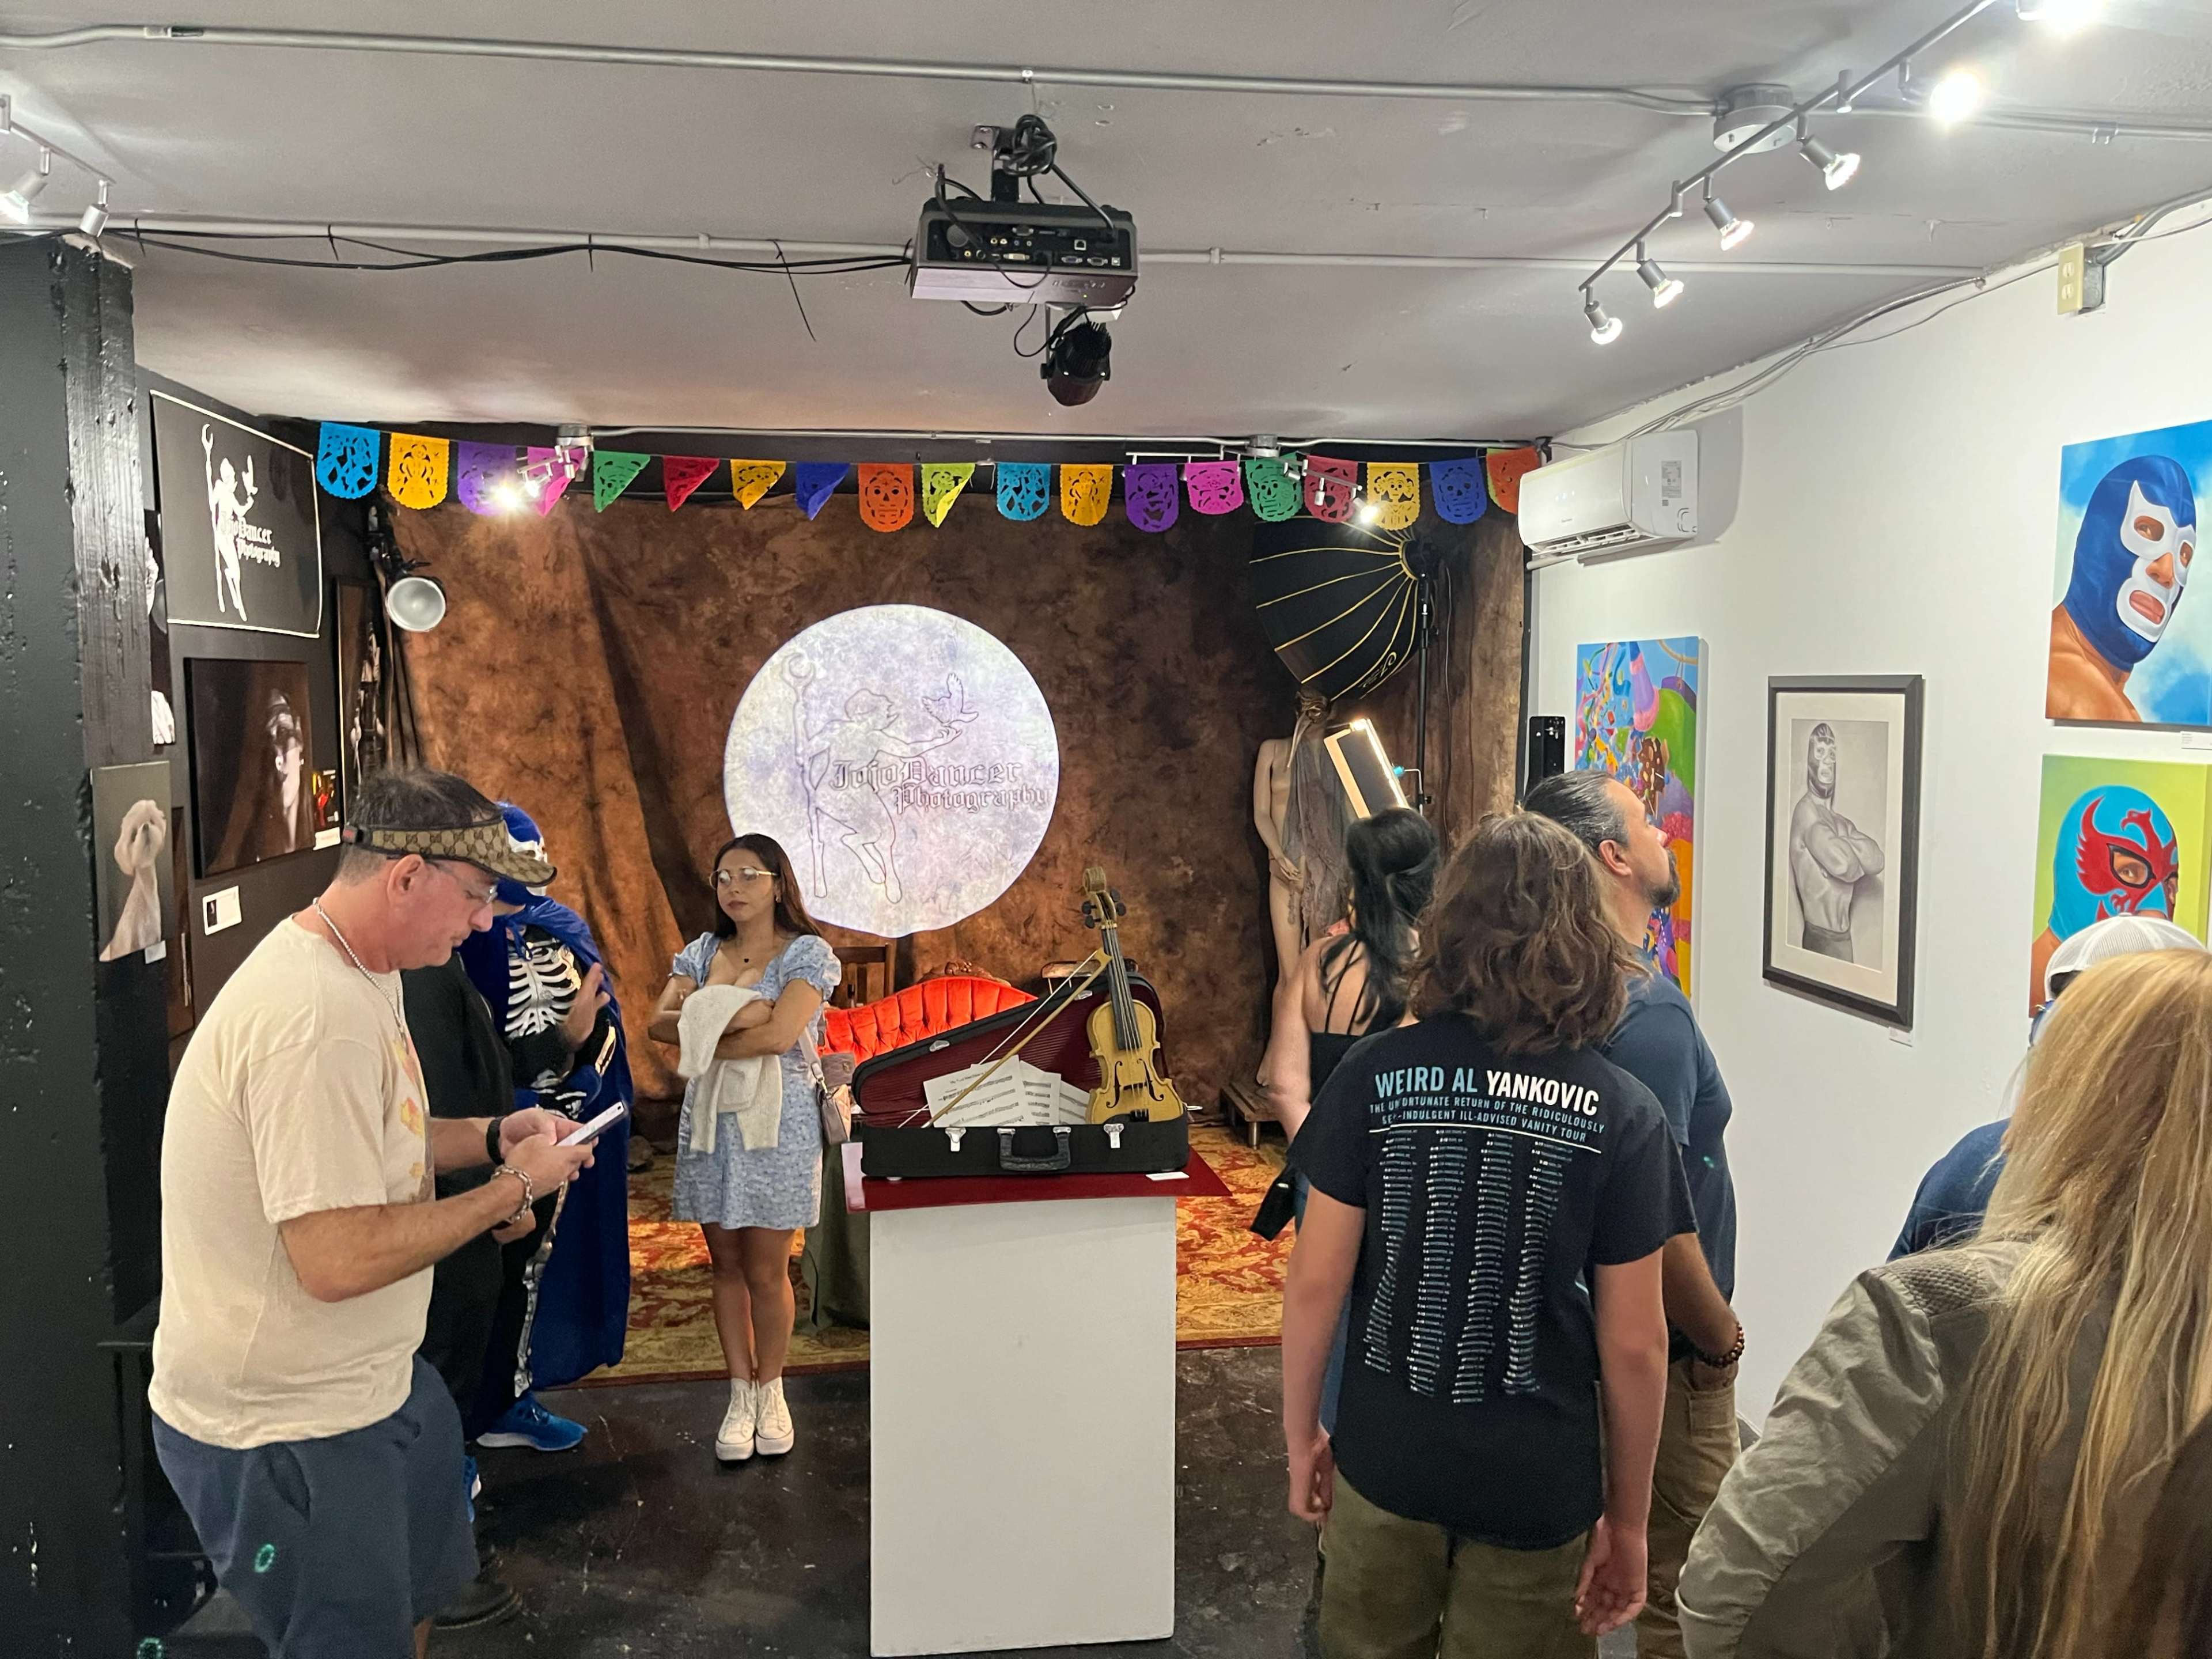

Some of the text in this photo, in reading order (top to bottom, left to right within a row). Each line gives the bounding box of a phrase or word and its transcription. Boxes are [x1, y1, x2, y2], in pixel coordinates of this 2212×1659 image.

[238, 516, 272, 544] Dancer
[891, 783, 1052, 815] Photography
[1375, 1066, 1600, 1116] WEIRD AL YANKOVIC
[1370, 1096, 1604, 1134] THE UNORTUNATE RETURN OF THE RIDICULOUSLY
[1382, 1110, 1586, 1143] SE-INDULGENT ILL-ADVISED VANITY TOUR
